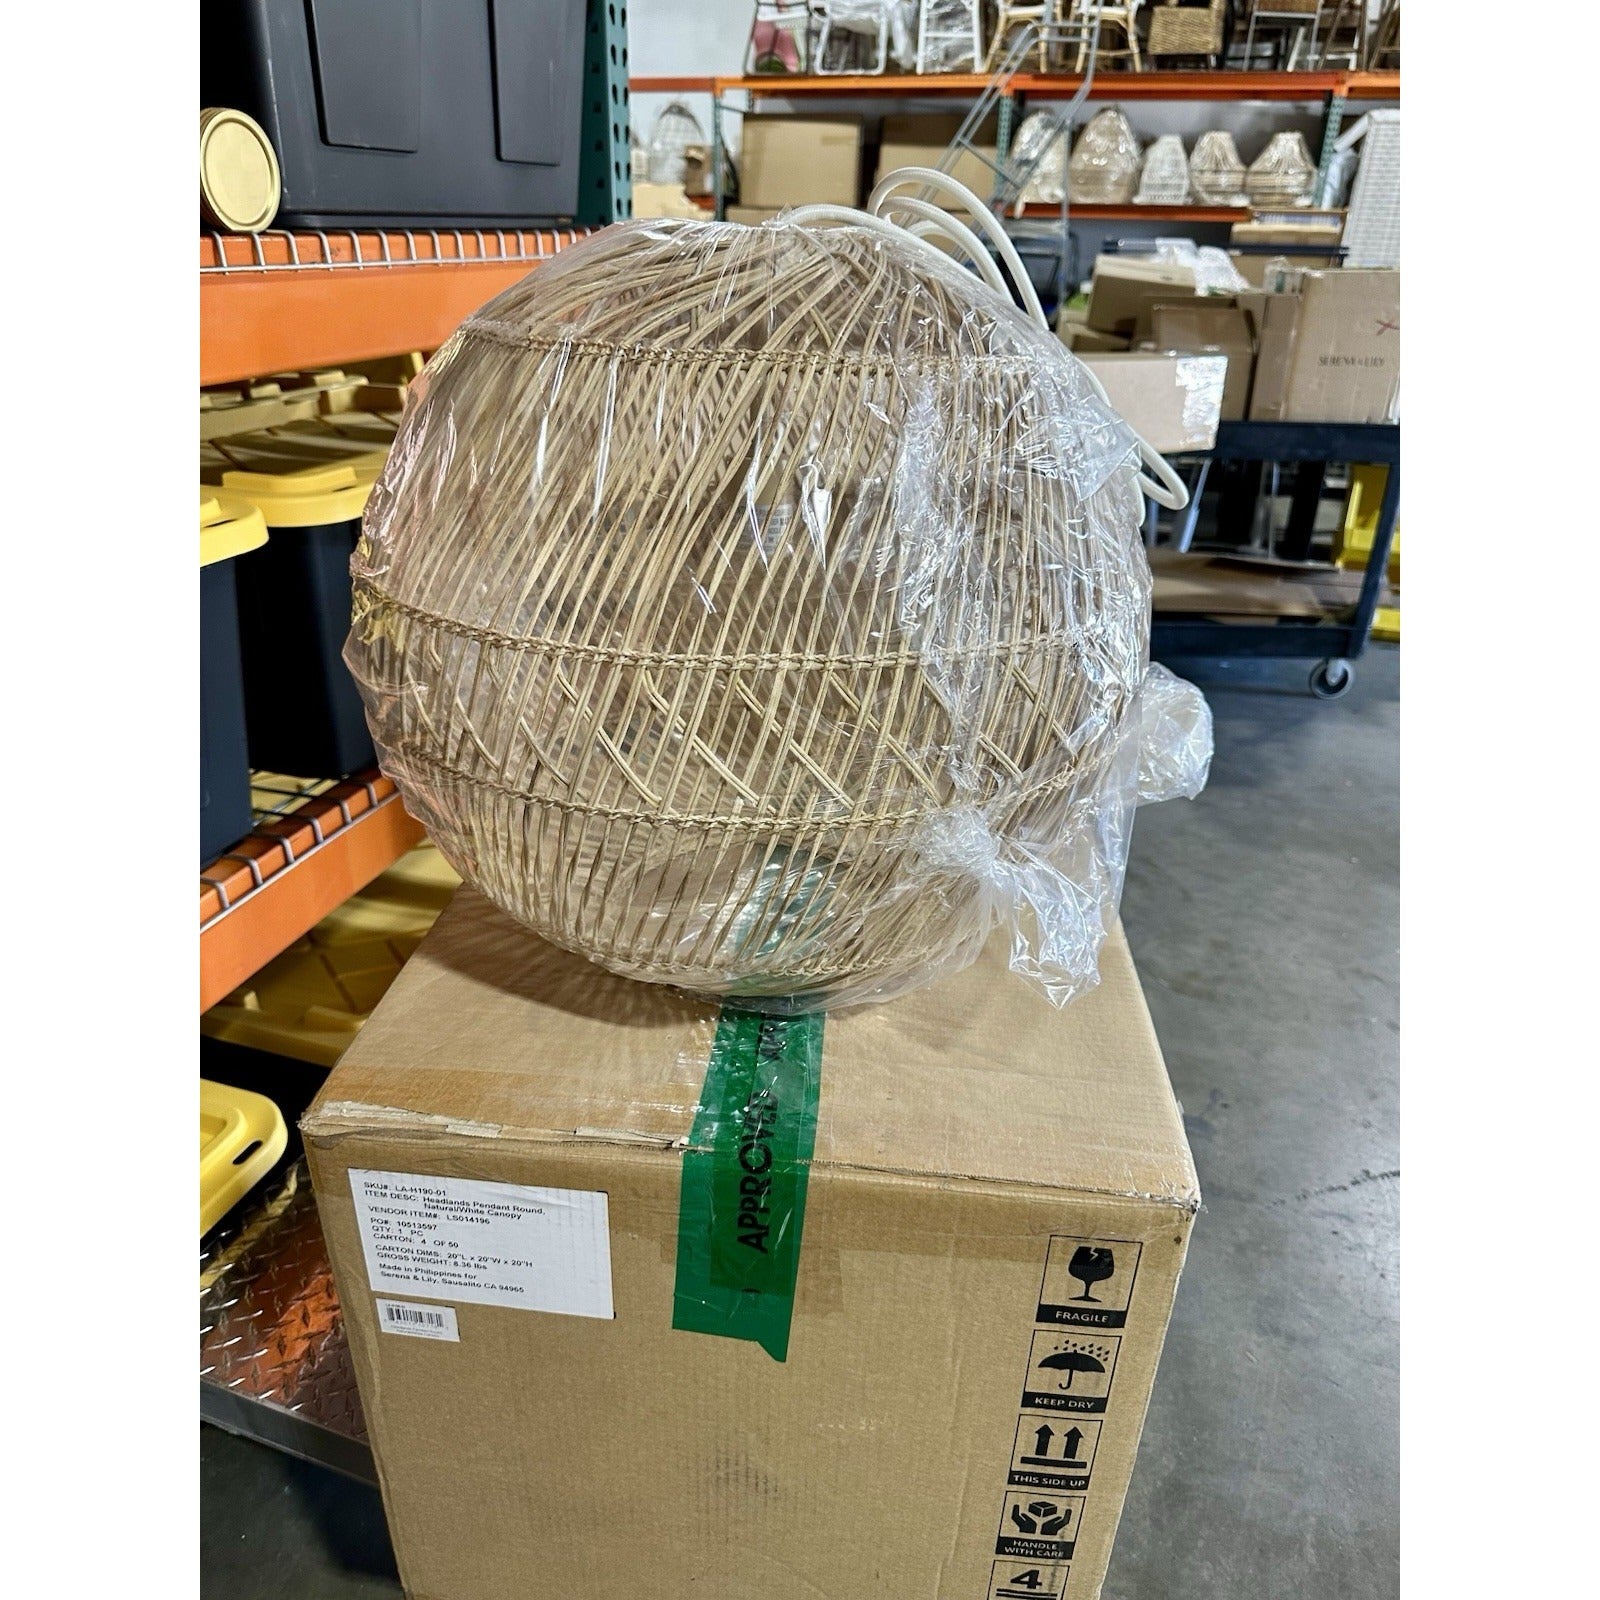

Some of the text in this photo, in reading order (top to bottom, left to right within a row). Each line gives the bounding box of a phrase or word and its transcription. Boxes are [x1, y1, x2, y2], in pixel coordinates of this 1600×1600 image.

[737, 1091, 779, 1255] APPROVED
[364, 1182, 446, 1196] SKU#: LA-H190-01
[365, 1190, 546, 1216] ITEM DESC: Headlands Pendant Round,
[368, 1205, 491, 1225] VENDOR ITEM#: LS014196
[424, 1203, 522, 1220] Natural/White Canopy
[370, 1217, 437, 1231] PO#: 10513597
[372, 1225, 394, 1234] QTY:
[410, 1229, 424, 1237] PC
[373, 1233, 415, 1244] CARTON:
[375, 1244, 414, 1255] CARTON
[416, 1249, 442, 1258] DIMS:
[377, 1252, 410, 1262] GROSS
[411, 1256, 452, 1267] WEIGHT:
[453, 1261, 472, 1269] 8.36
[379, 1263, 402, 1271] Made
[414, 1267, 462, 1279] Philippines
[381, 1271, 411, 1280] Serena
[421, 1276, 440, 1284] Lily,
[441, 1278, 482, 1288] Sausalito
[484, 1282, 497, 1290] CA
[498, 1284, 525, 1293] 94965
[1055, 1310, 1109, 1323] FRAGILE
[1034, 1397, 1095, 1410] KEEP DRY
[1013, 1475, 1039, 1484] THIS
[1042, 1477, 1067, 1486] SIDE
[1004, 1546, 1065, 1558] WITH CARE
[1013, 1540, 1058, 1550] HANDLE
[1010, 1569, 1043, 1590] 4
